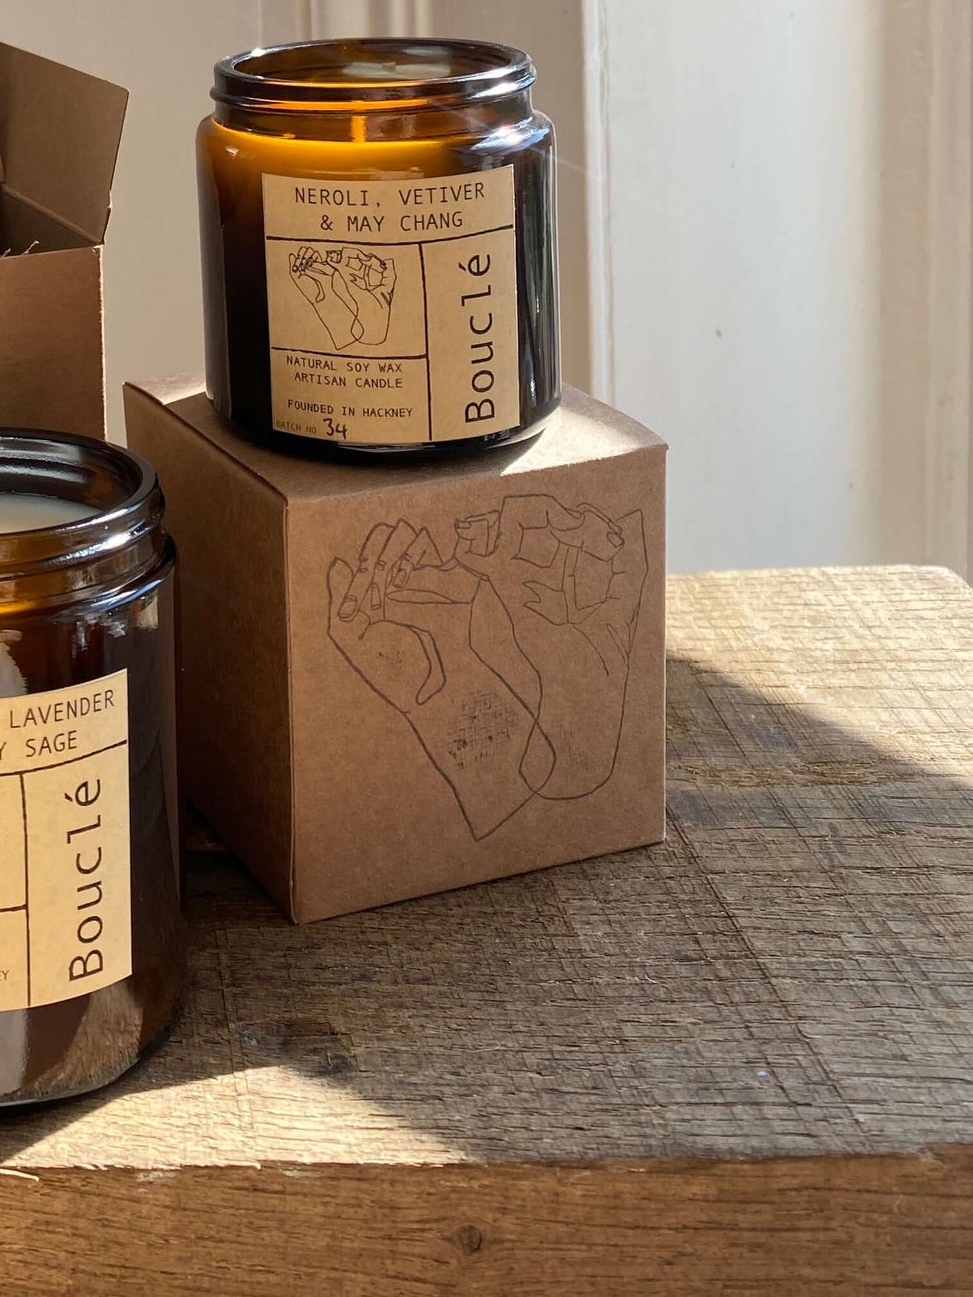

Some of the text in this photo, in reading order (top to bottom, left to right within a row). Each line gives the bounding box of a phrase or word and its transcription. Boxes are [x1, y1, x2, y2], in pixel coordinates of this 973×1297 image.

[294, 182, 485, 208] NEROLI, VETIVER
[320, 211, 464, 232] & MAY CHANG
[458, 253, 495, 424] Bouclé
[286, 355, 403, 373] NATURAL SOY WAX
[294, 372, 403, 389] ARTISAN CANDLE
[287, 399, 413, 418] FOUNDED IN HACKNEY
[275, 417, 348, 440] BATCH NO 34
[9, 689, 115, 729] LAVENDER
[25, 730, 79, 759] SAGE
[64, 778, 104, 983] Bouclé
